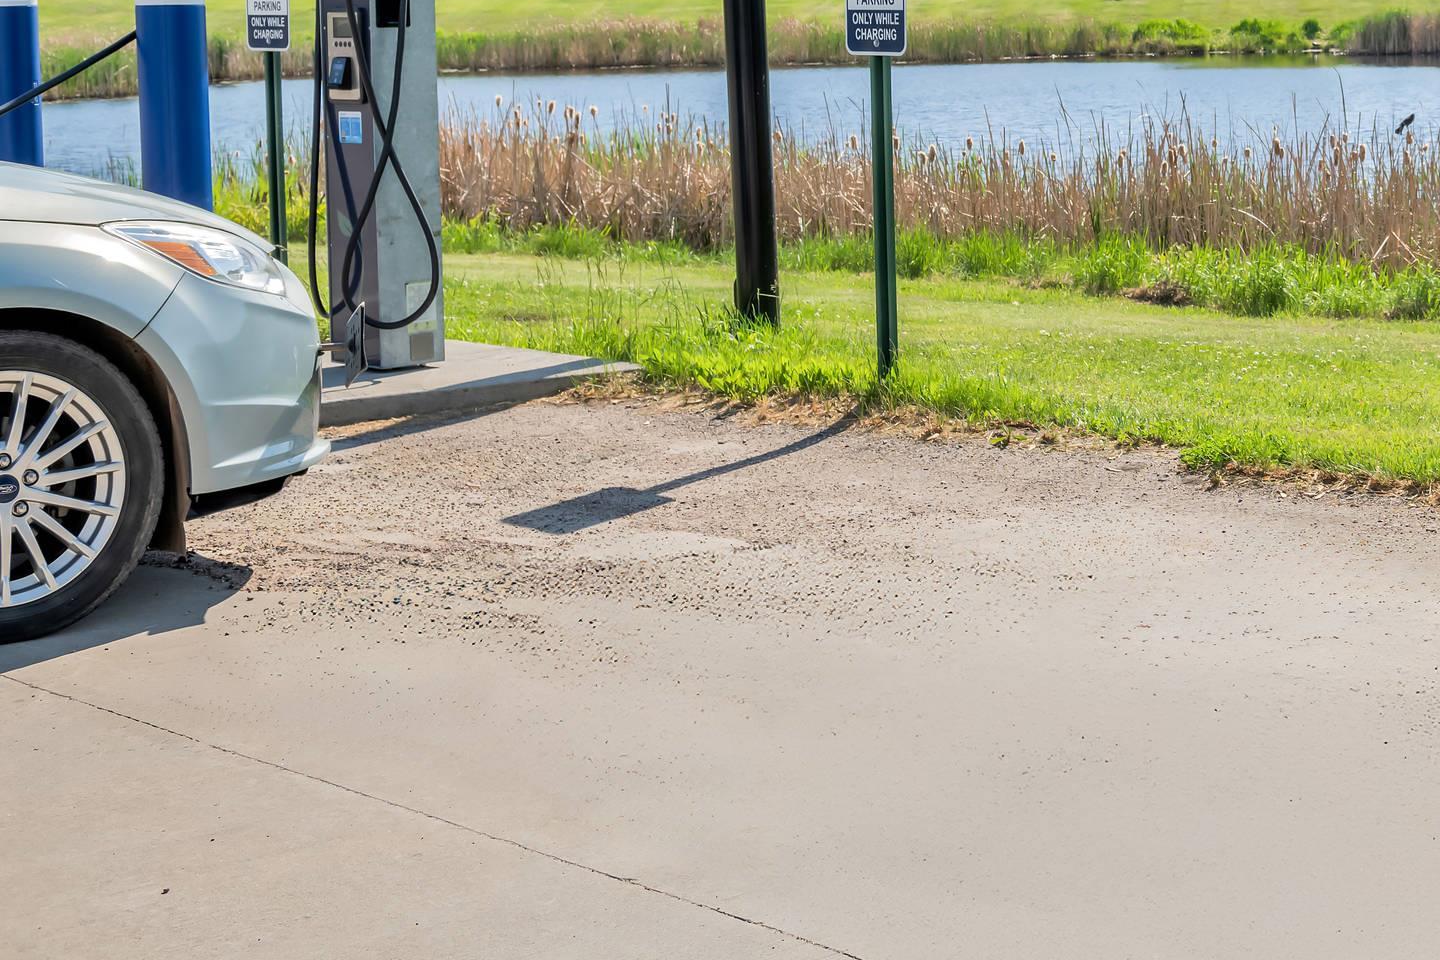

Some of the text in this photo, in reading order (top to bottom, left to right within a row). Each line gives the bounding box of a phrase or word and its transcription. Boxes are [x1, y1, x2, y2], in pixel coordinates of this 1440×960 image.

[253, 1, 281, 12] PARKING
[251, 17, 285, 27] ONLY WHILE
[852, 12, 900, 25] ONLY WHILE
[253, 29, 284, 40] CHARGING
[855, 28, 897, 41] CHARGING
